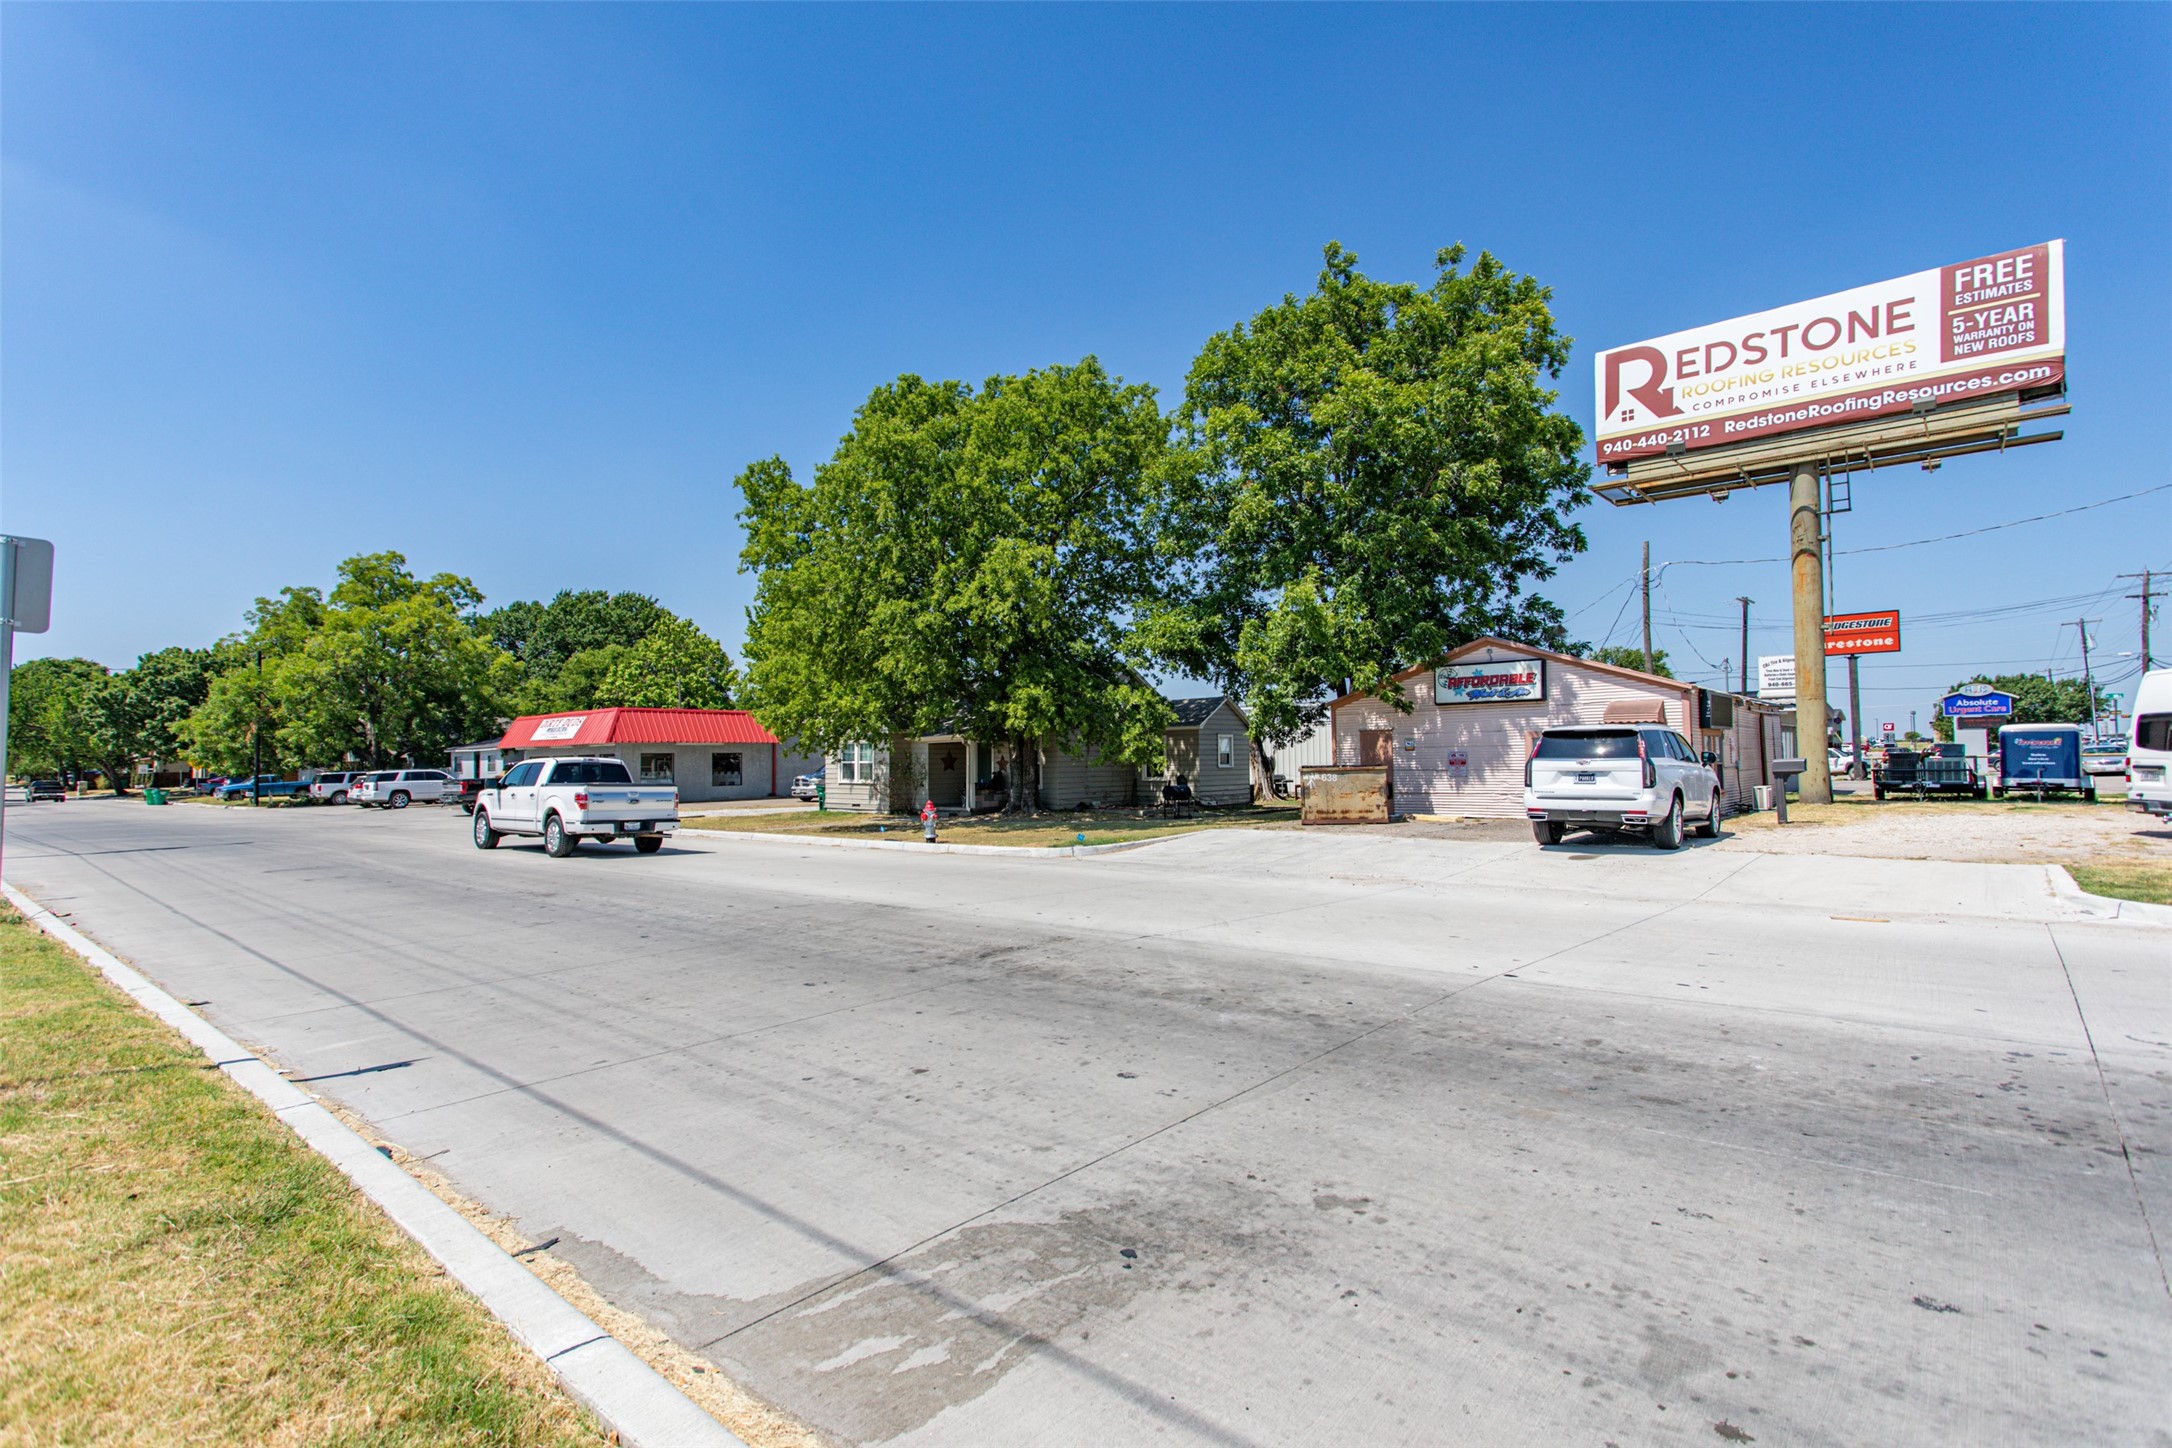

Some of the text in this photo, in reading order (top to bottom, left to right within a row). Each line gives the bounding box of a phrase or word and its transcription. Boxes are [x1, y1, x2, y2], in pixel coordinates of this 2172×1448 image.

[1955, 254, 2034, 293] FREE
[1955, 280, 2033, 306] ESTIMATES
[1952, 302, 2034, 334] 5-YEAR
[1953, 320, 2035, 344] WARRANTY ON
[1954, 331, 2035, 356] NEW ROOFS
[1605, 296, 1916, 420] REDSTONE
[1682, 339, 1917, 399] ROOFING RESOURCES
[1693, 360, 1917, 412] COMPROMISE ELSEWHERE
[1603, 366, 2051, 455] 940-440-2112 RedstoneRoofingResources.com
[1447, 672, 1536, 690] AFFORDABLE
[1949, 706, 1983, 715] Urgent
[1956, 698, 1999, 706] Absolute
[1321, 773, 1338, 782] 638
